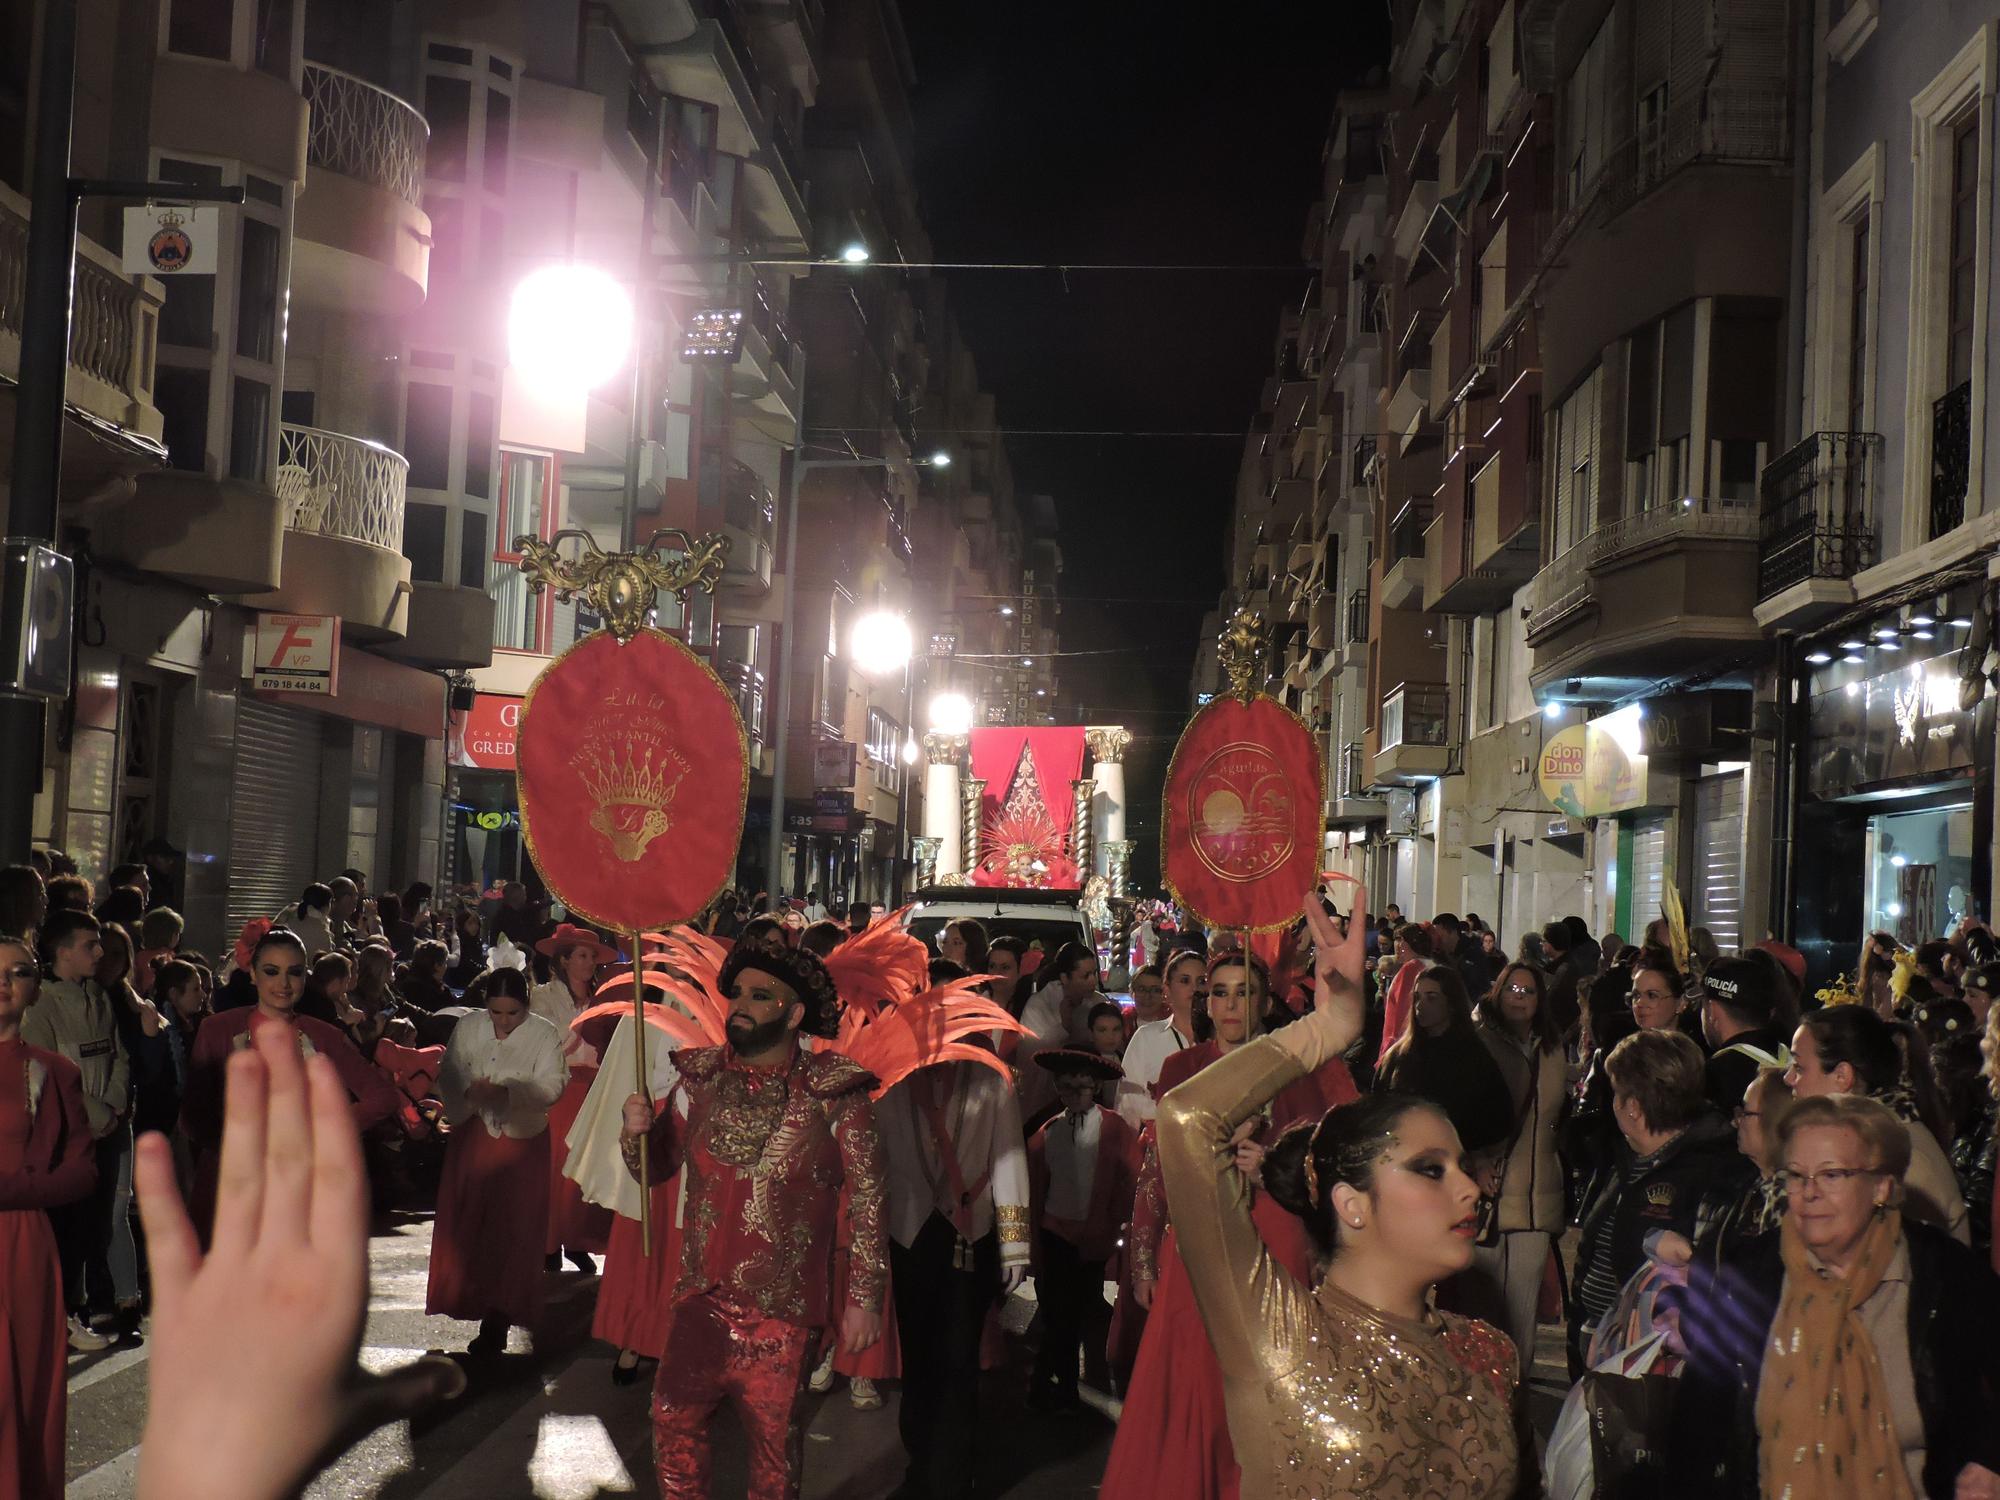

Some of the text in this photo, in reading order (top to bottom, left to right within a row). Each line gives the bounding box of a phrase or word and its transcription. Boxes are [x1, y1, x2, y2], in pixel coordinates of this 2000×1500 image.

[1020, 569, 1034, 668] MUEBLE
[292, 655, 311, 667] VP
[262, 679, 321, 690] 679 18 44 84
[1552, 742, 1583, 760] don
[1545, 755, 1584, 774] Dino
[1707, 976, 1738, 994] POLICÍA
